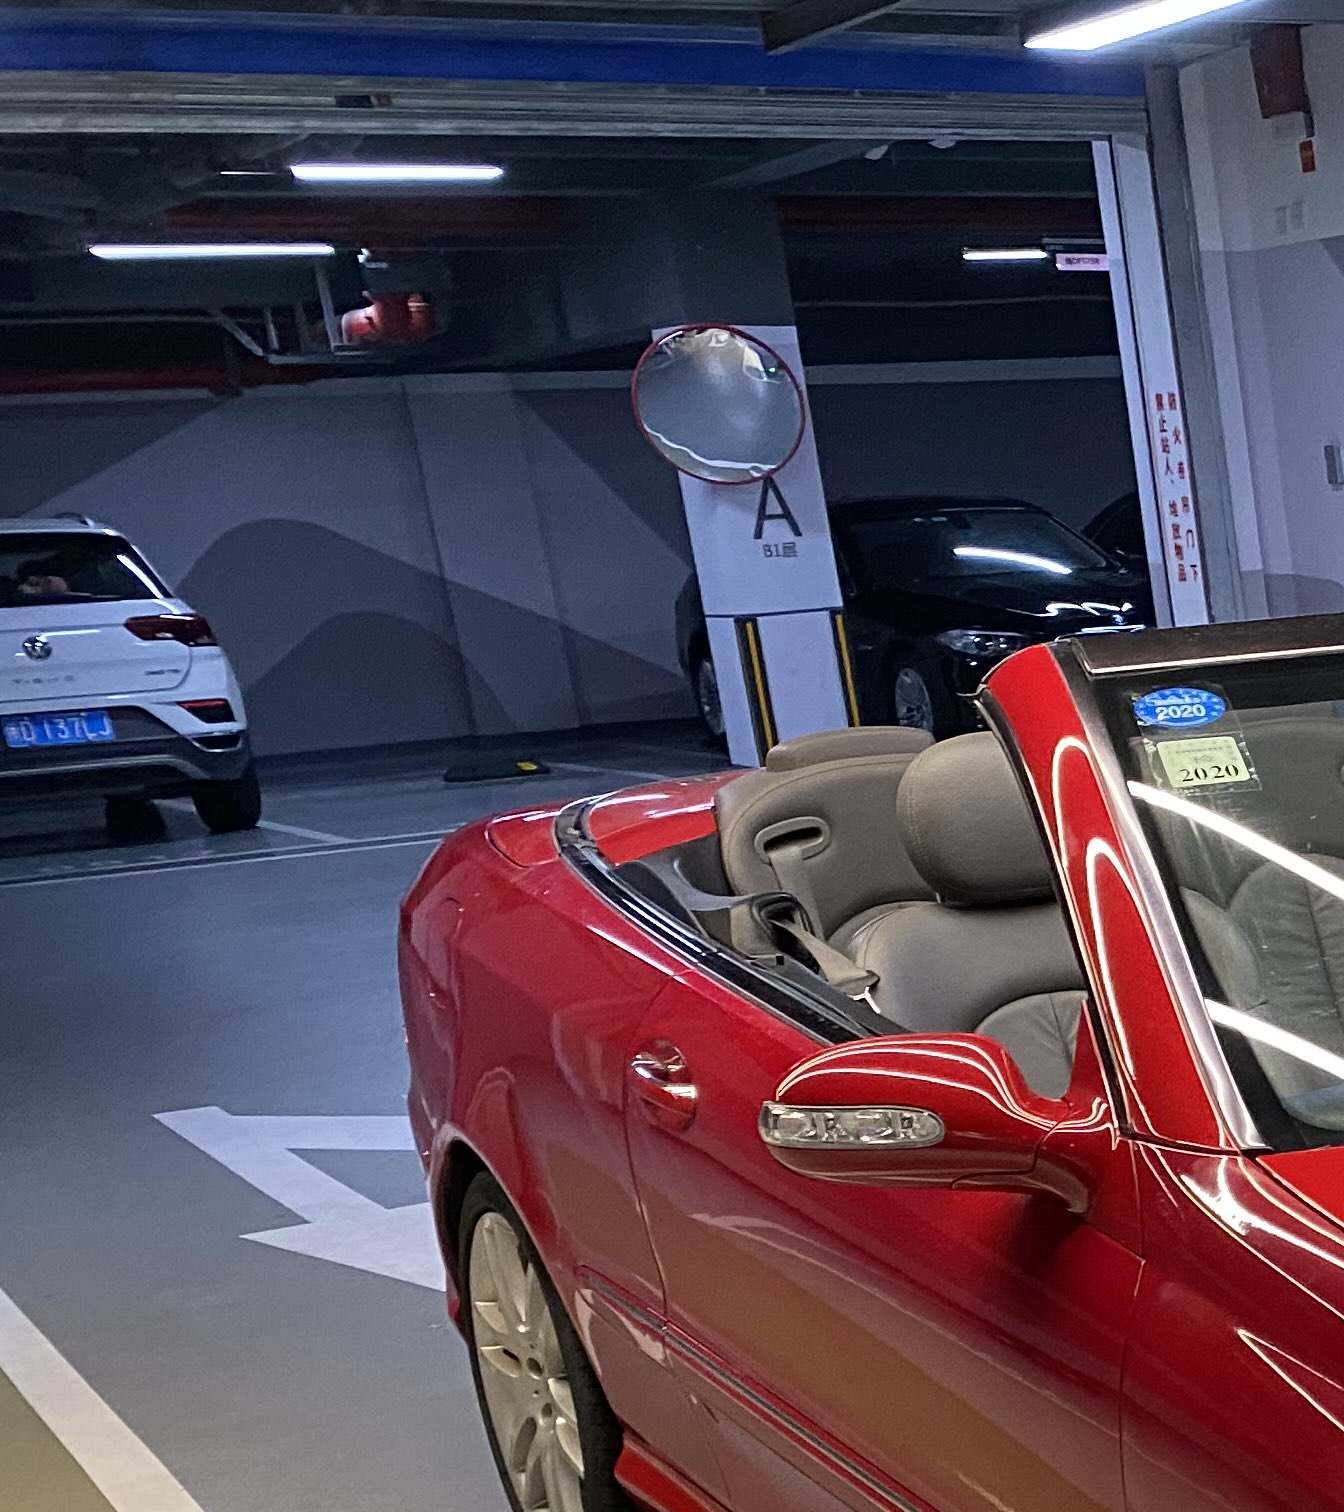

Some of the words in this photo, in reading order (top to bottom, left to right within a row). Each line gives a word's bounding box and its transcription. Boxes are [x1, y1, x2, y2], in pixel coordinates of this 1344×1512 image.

[753, 476, 802, 540] A
[762, 542, 799, 558] B1层
[1155, 704, 1206, 721] 2020
[1178, 764, 1239, 782] 2020
